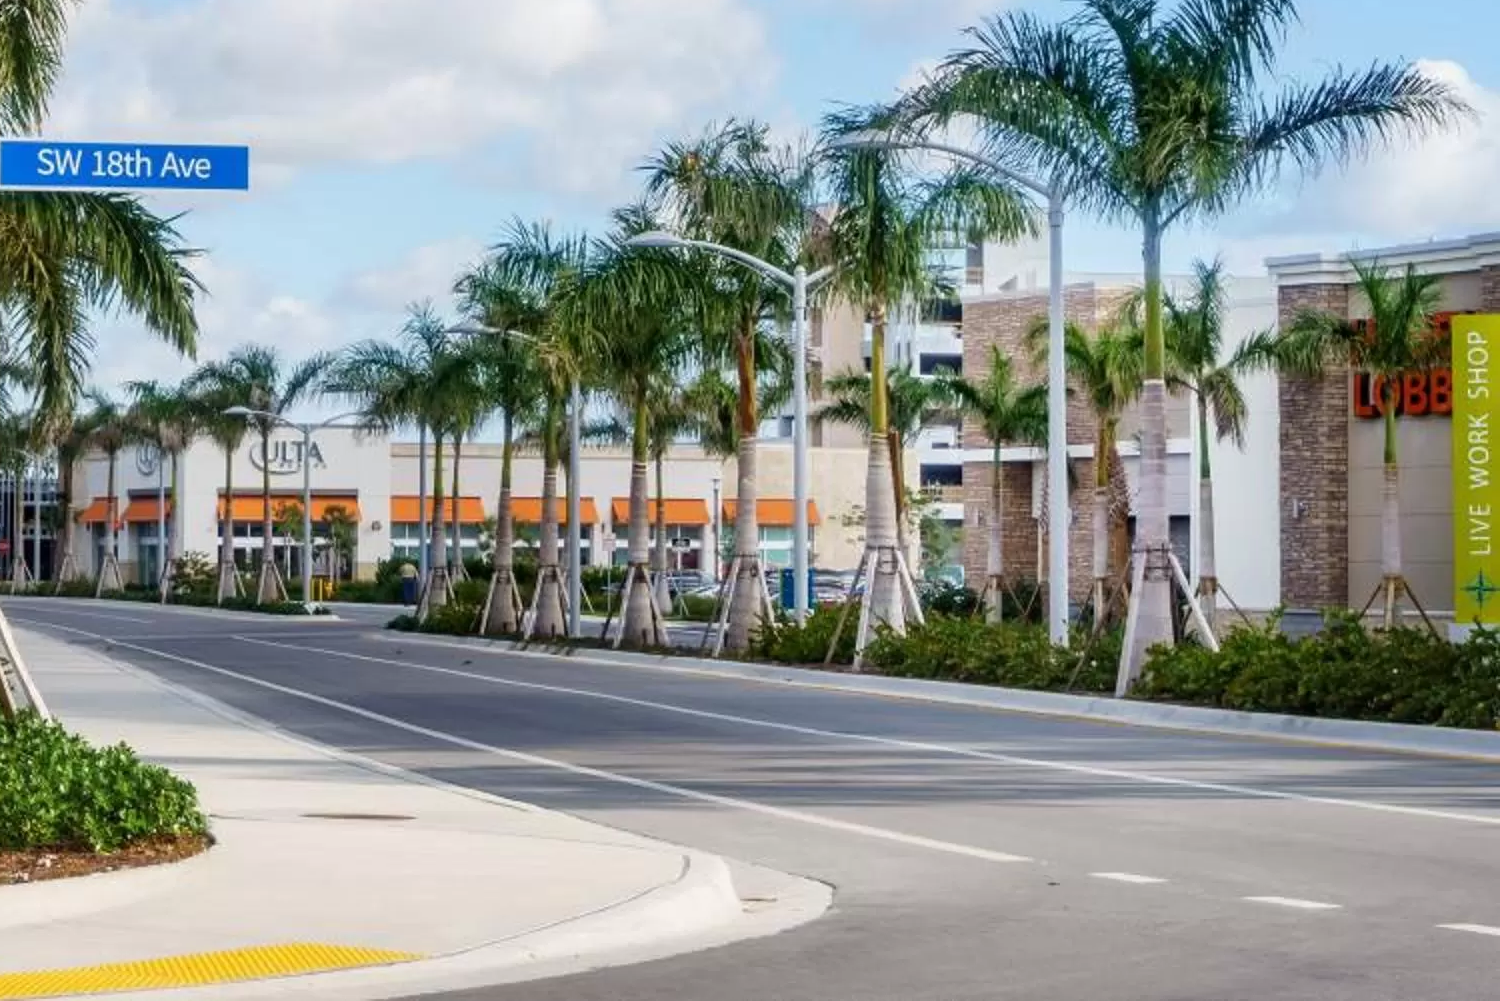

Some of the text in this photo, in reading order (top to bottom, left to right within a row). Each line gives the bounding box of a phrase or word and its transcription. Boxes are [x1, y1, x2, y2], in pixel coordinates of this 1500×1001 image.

[37, 148, 212, 179] SW 18th Ave
[1354, 367, 1453, 417] LOBB
[1467, 331, 1491, 555] LIVE WORK SHOP
